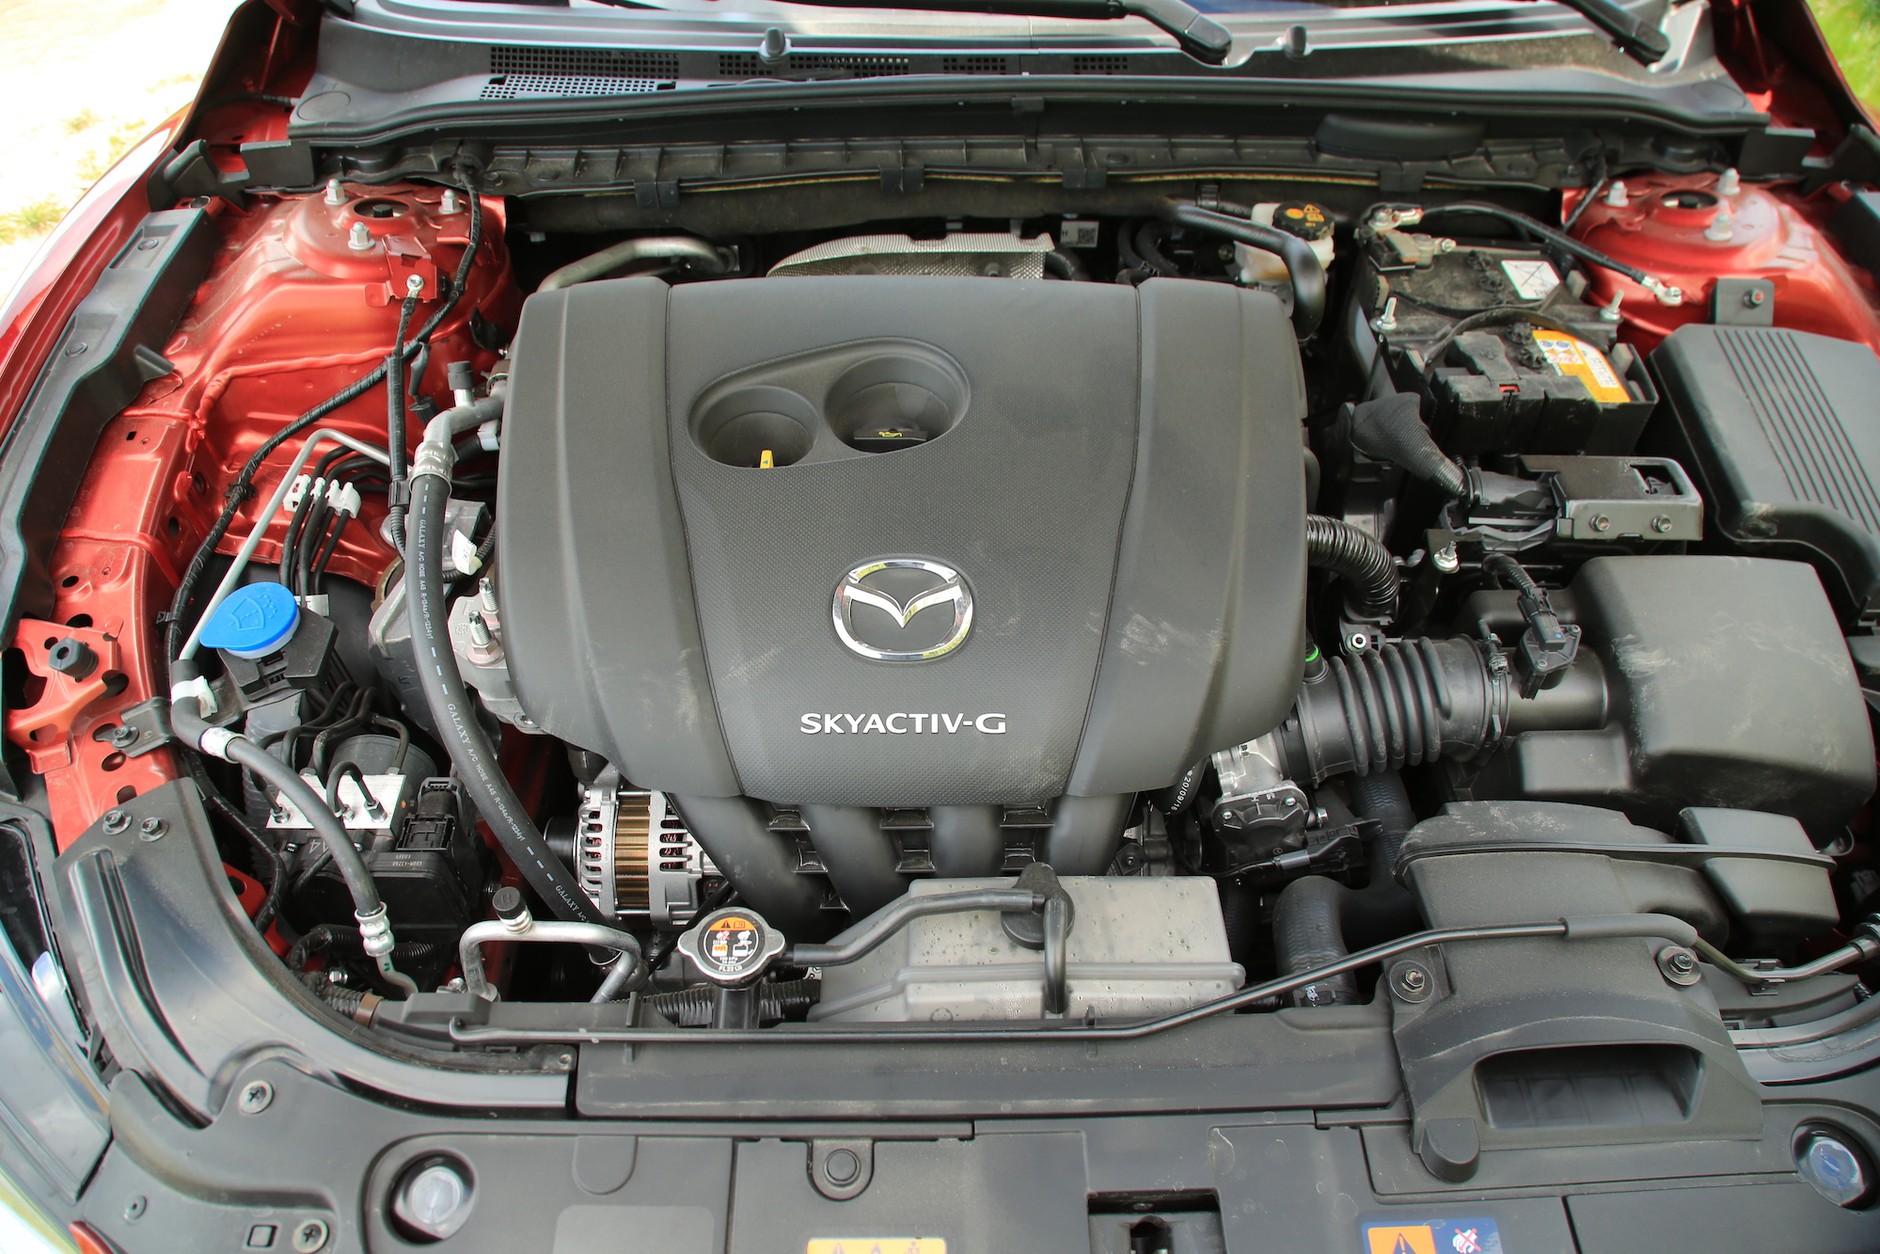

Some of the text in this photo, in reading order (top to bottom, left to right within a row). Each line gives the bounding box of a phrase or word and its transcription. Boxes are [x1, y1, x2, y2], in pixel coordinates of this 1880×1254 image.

[418, 519, 426, 549] GALAXY
[800, 712, 1007, 734] SKYACTIV-G
[447, 703, 471, 744] GALAXY
[467, 748, 478, 763] A/C
[475, 764, 489, 782] HOSE
[485, 783, 497, 796] A45
[555, 885, 580, 911] GALAXY
